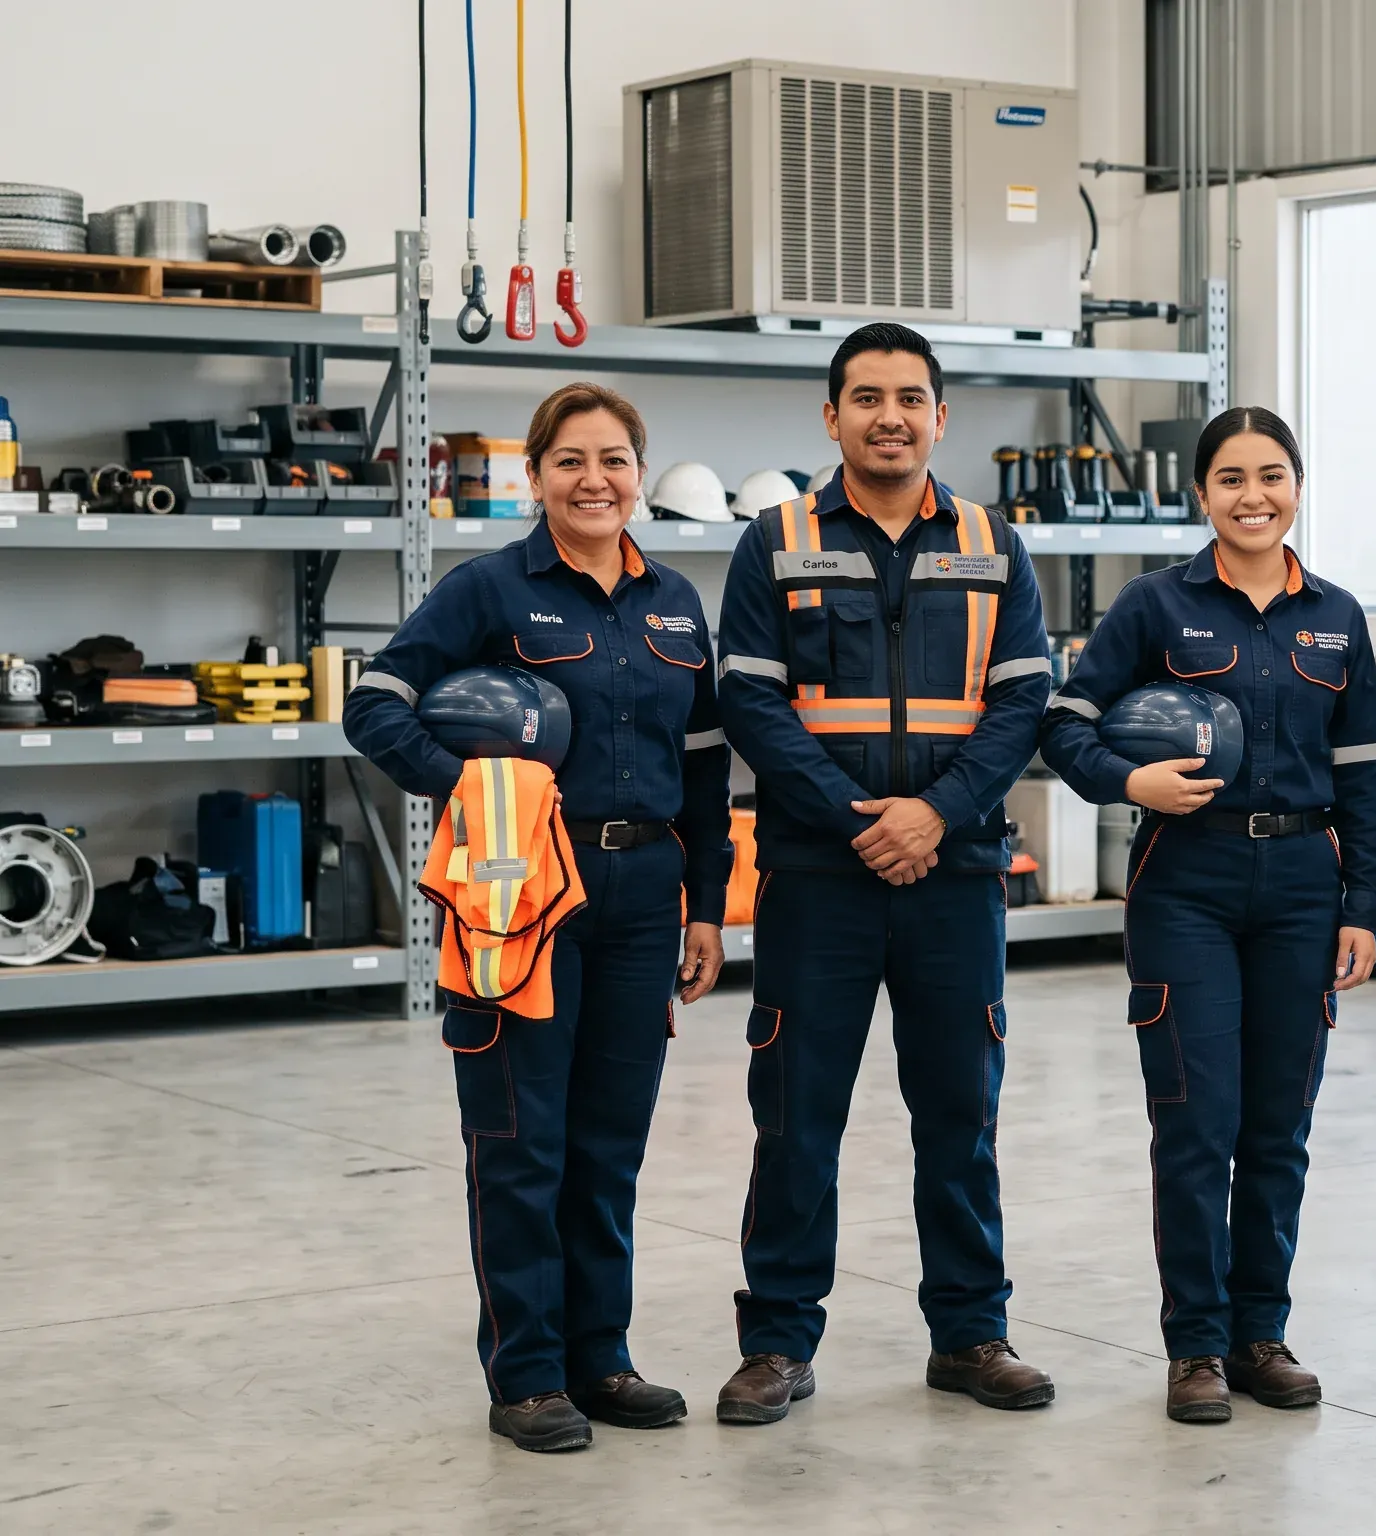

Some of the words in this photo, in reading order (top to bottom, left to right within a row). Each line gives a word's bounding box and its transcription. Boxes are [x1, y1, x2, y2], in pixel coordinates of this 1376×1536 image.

[802, 560, 837, 569] Carlos
[530, 612, 564, 624] Maria
[1182, 627, 1214, 638] Elena
